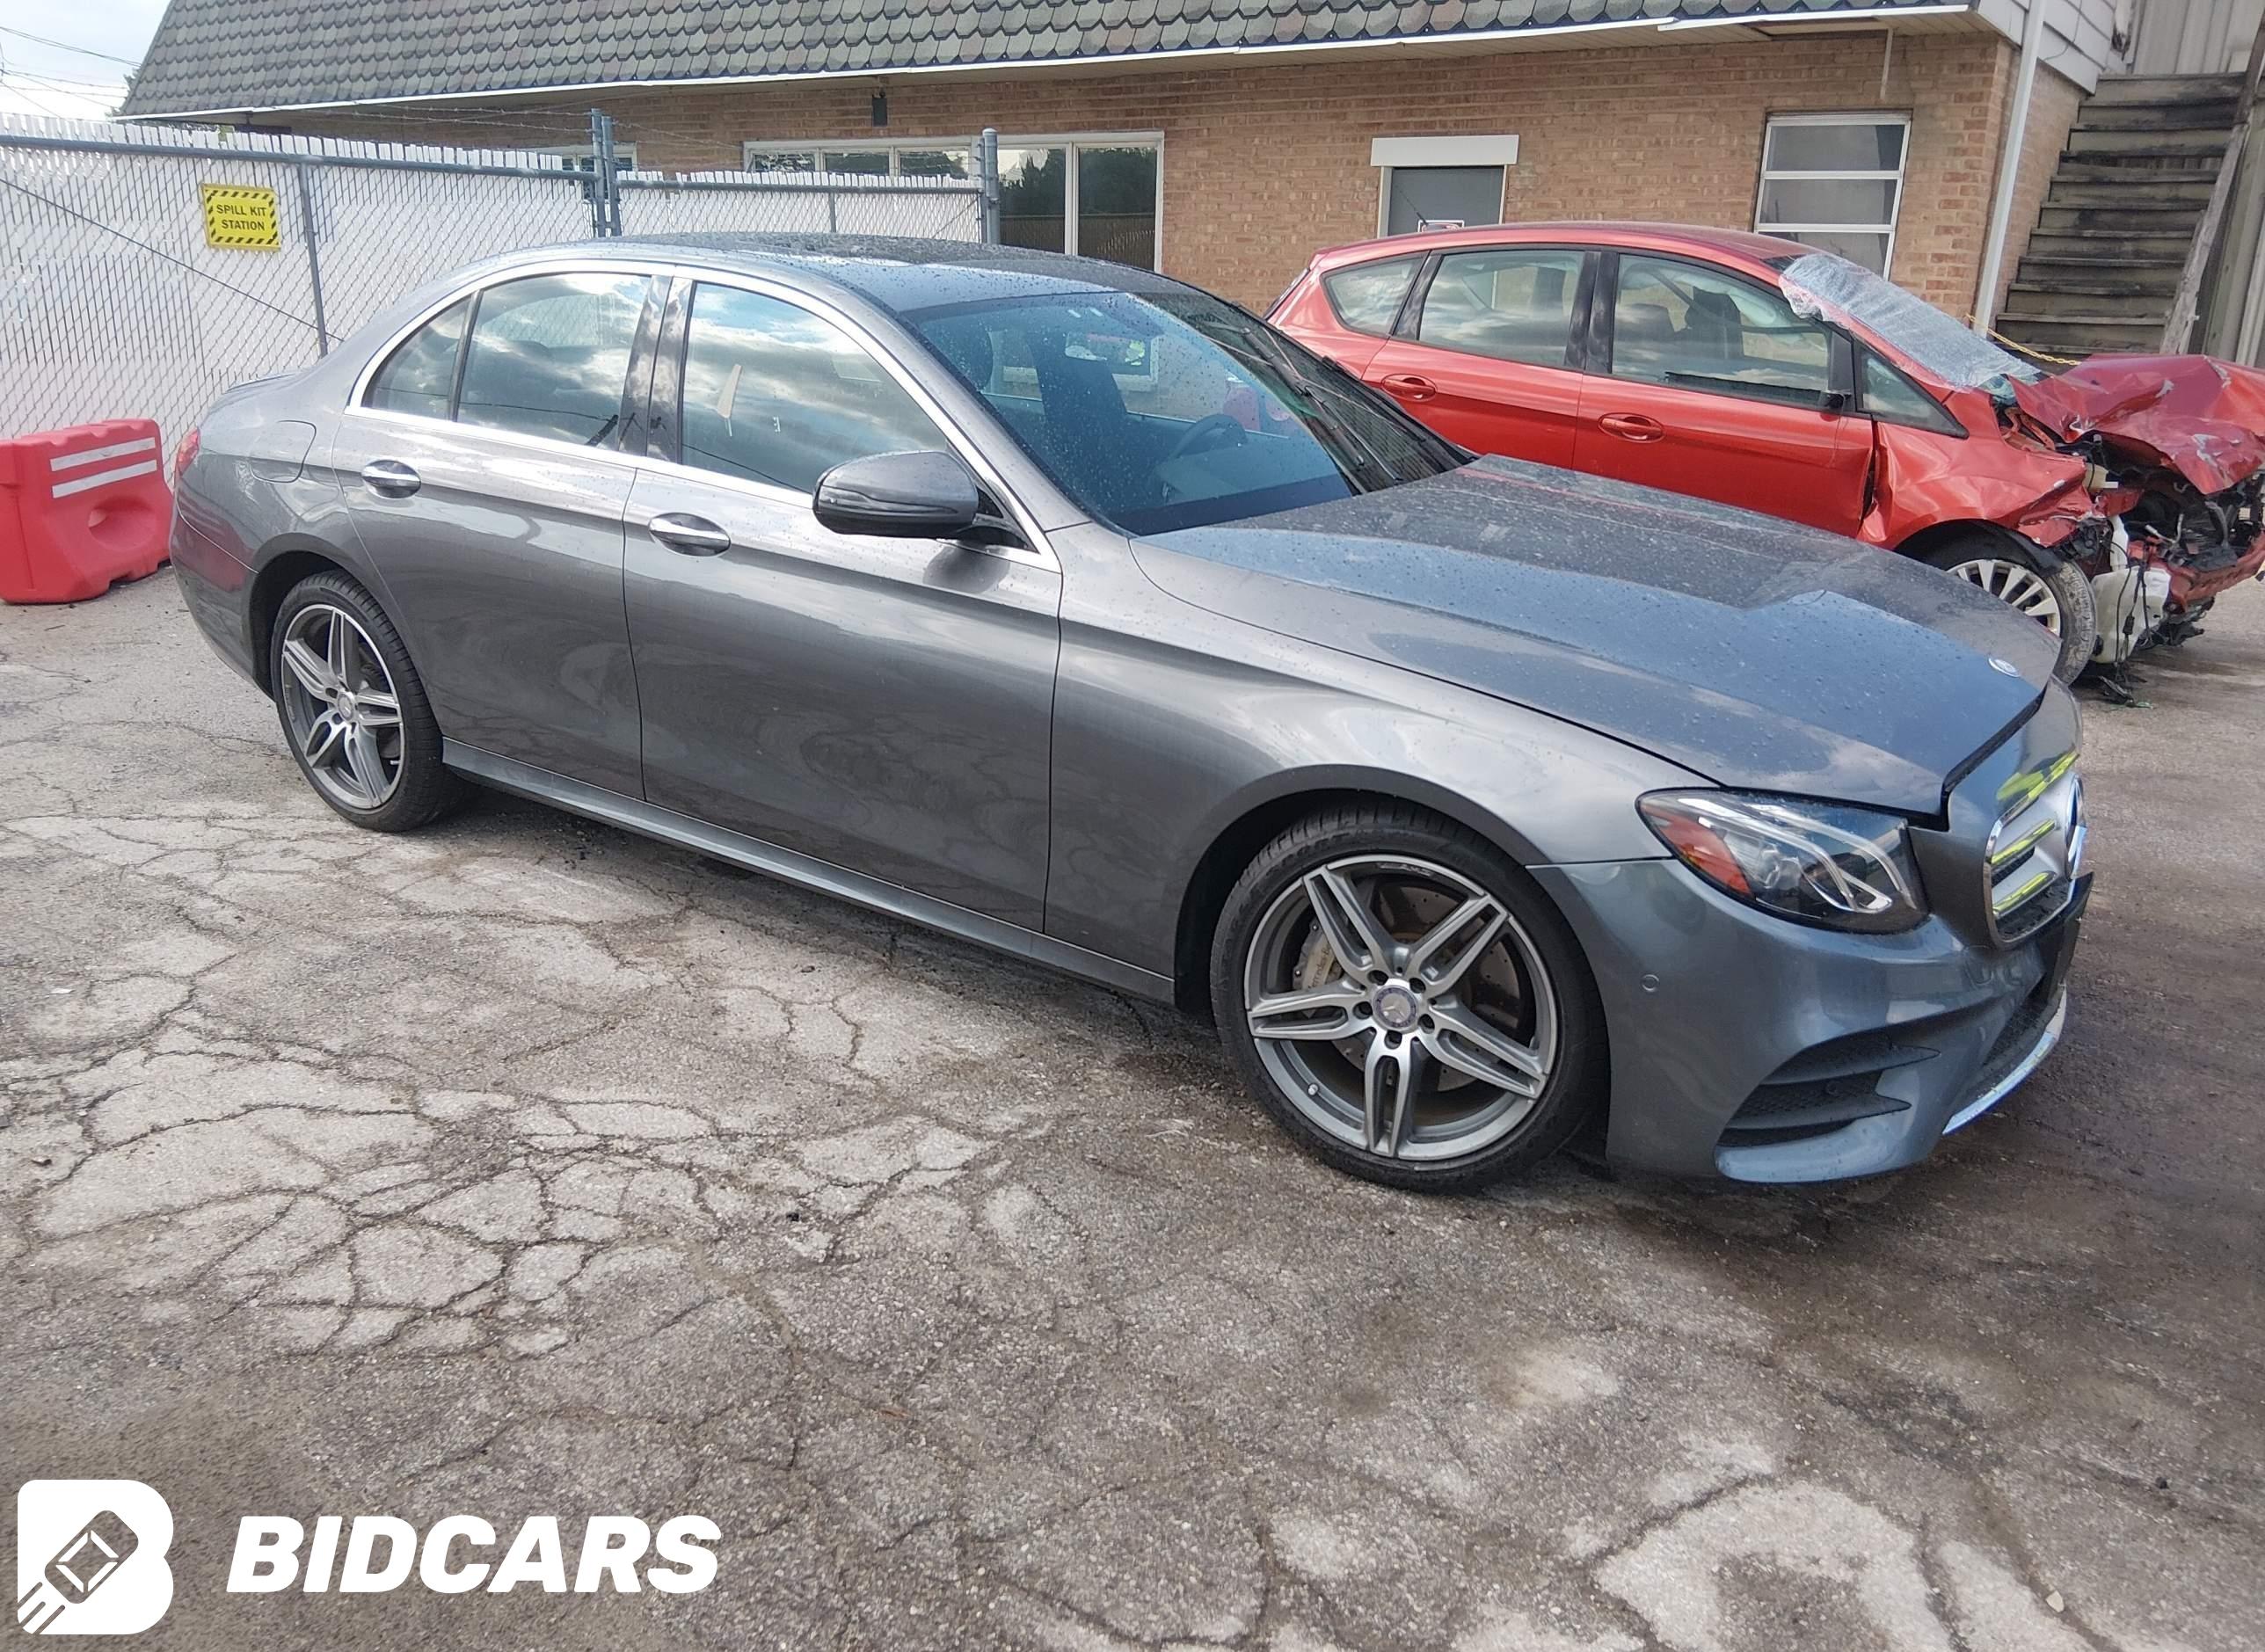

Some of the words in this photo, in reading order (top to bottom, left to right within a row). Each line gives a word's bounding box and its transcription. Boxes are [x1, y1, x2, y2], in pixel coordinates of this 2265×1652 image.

[216, 204, 247, 215] SPILL
[250, 206, 266, 216] KIT
[222, 219, 266, 231] STATION
